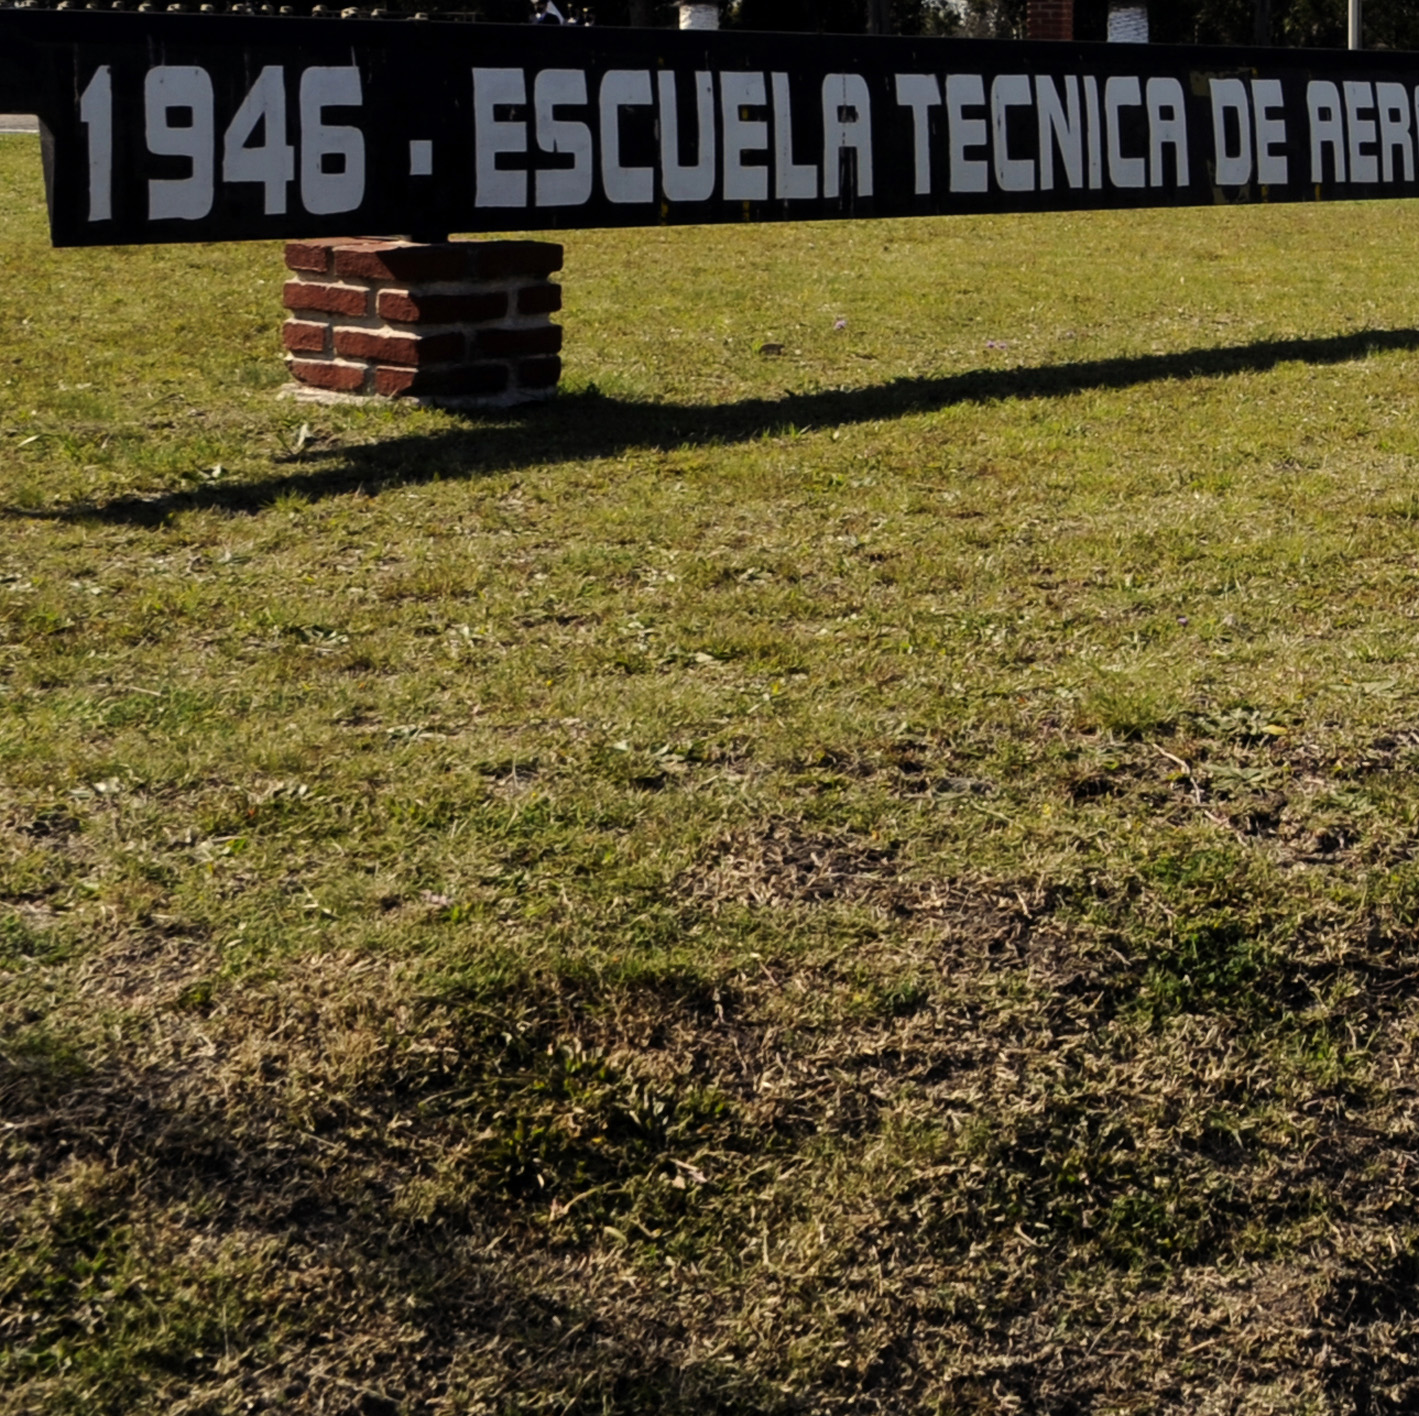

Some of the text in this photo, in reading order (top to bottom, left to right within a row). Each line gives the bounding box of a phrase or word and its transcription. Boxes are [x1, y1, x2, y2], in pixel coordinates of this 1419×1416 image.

[81, 66, 365, 221] 1946
[473, 68, 873, 207] ESCUELA
[895, 74, 1190, 194] TECNICA
[1209, 78, 1287, 185] DE
